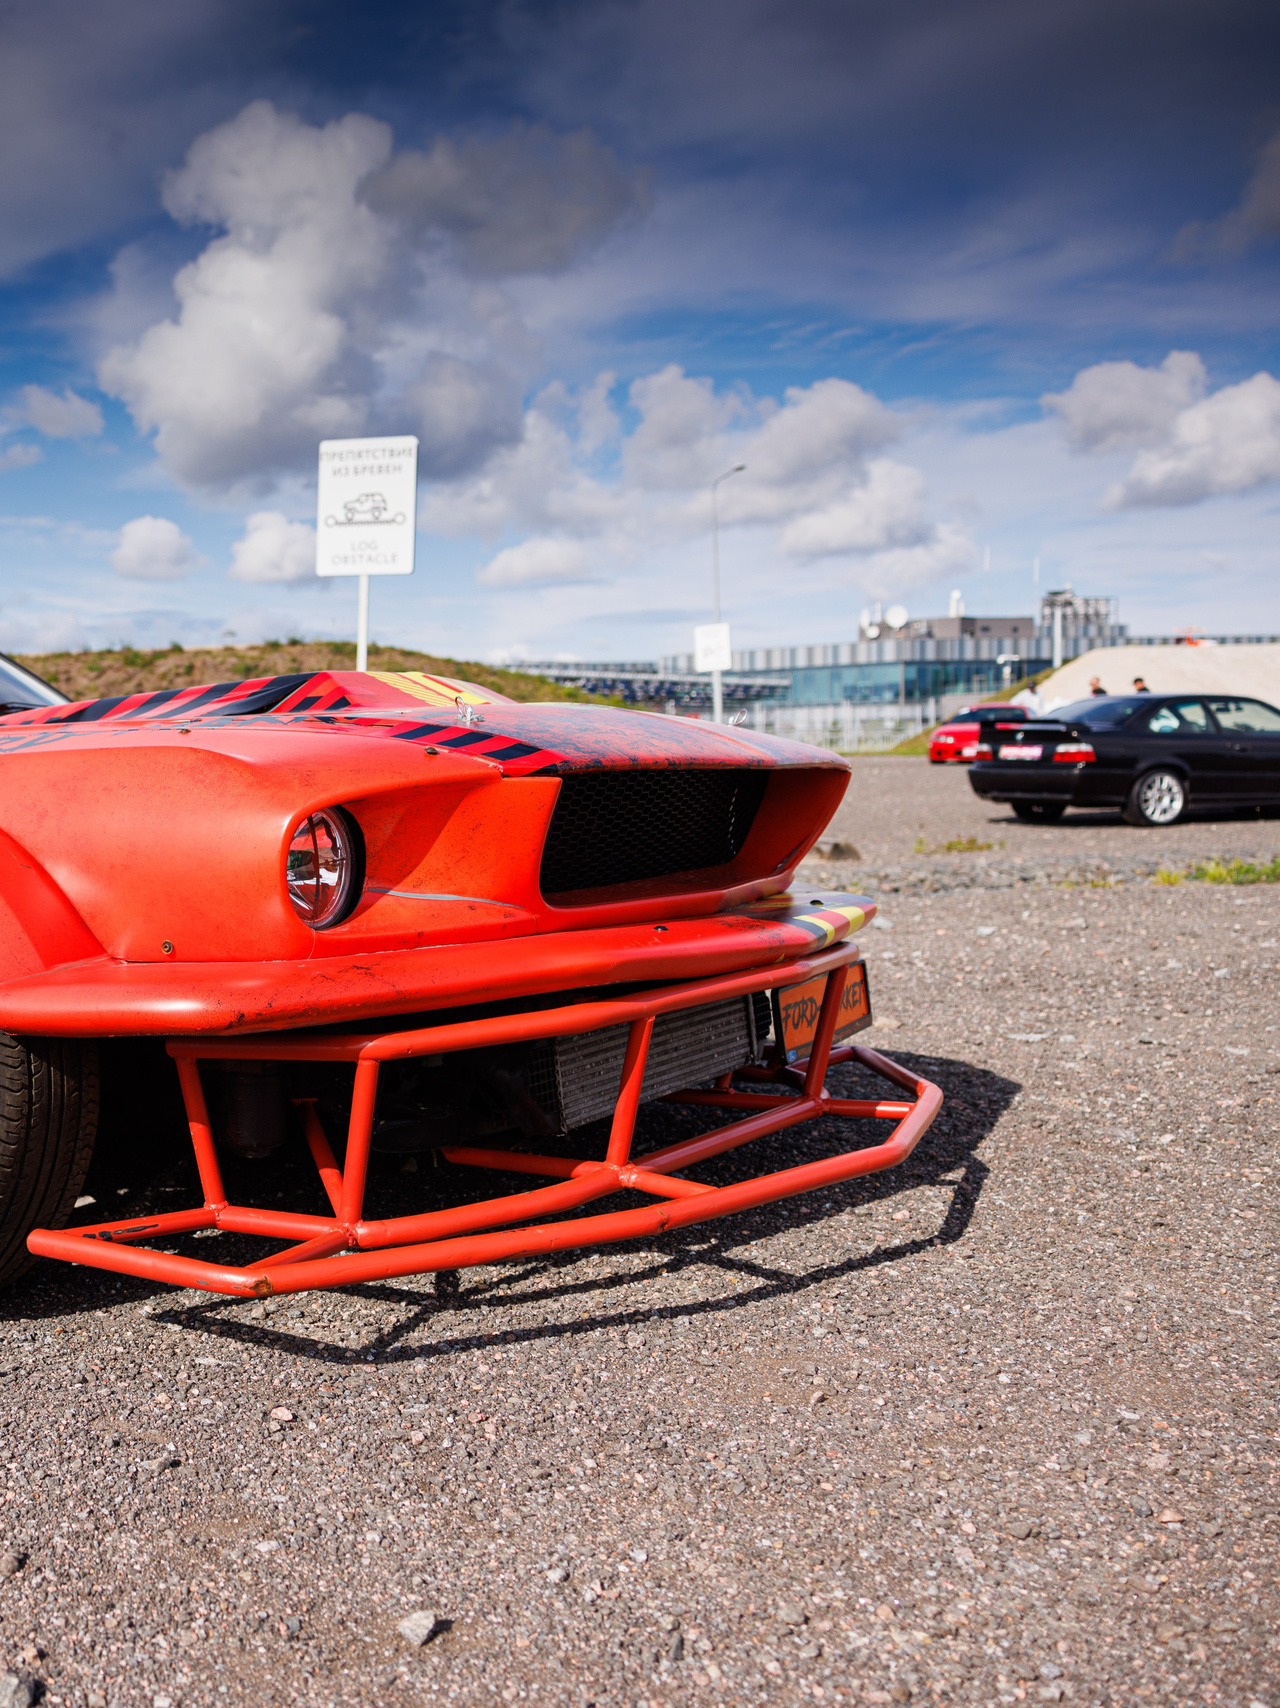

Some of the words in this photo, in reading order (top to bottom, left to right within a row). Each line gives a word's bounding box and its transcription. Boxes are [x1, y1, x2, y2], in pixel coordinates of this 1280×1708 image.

[332, 467, 350, 477] ИЗ
[354, 464, 403, 476] БРЕВЕН
[350, 540, 379, 552] LOG
[331, 552, 398, 565] OBSTACLE
